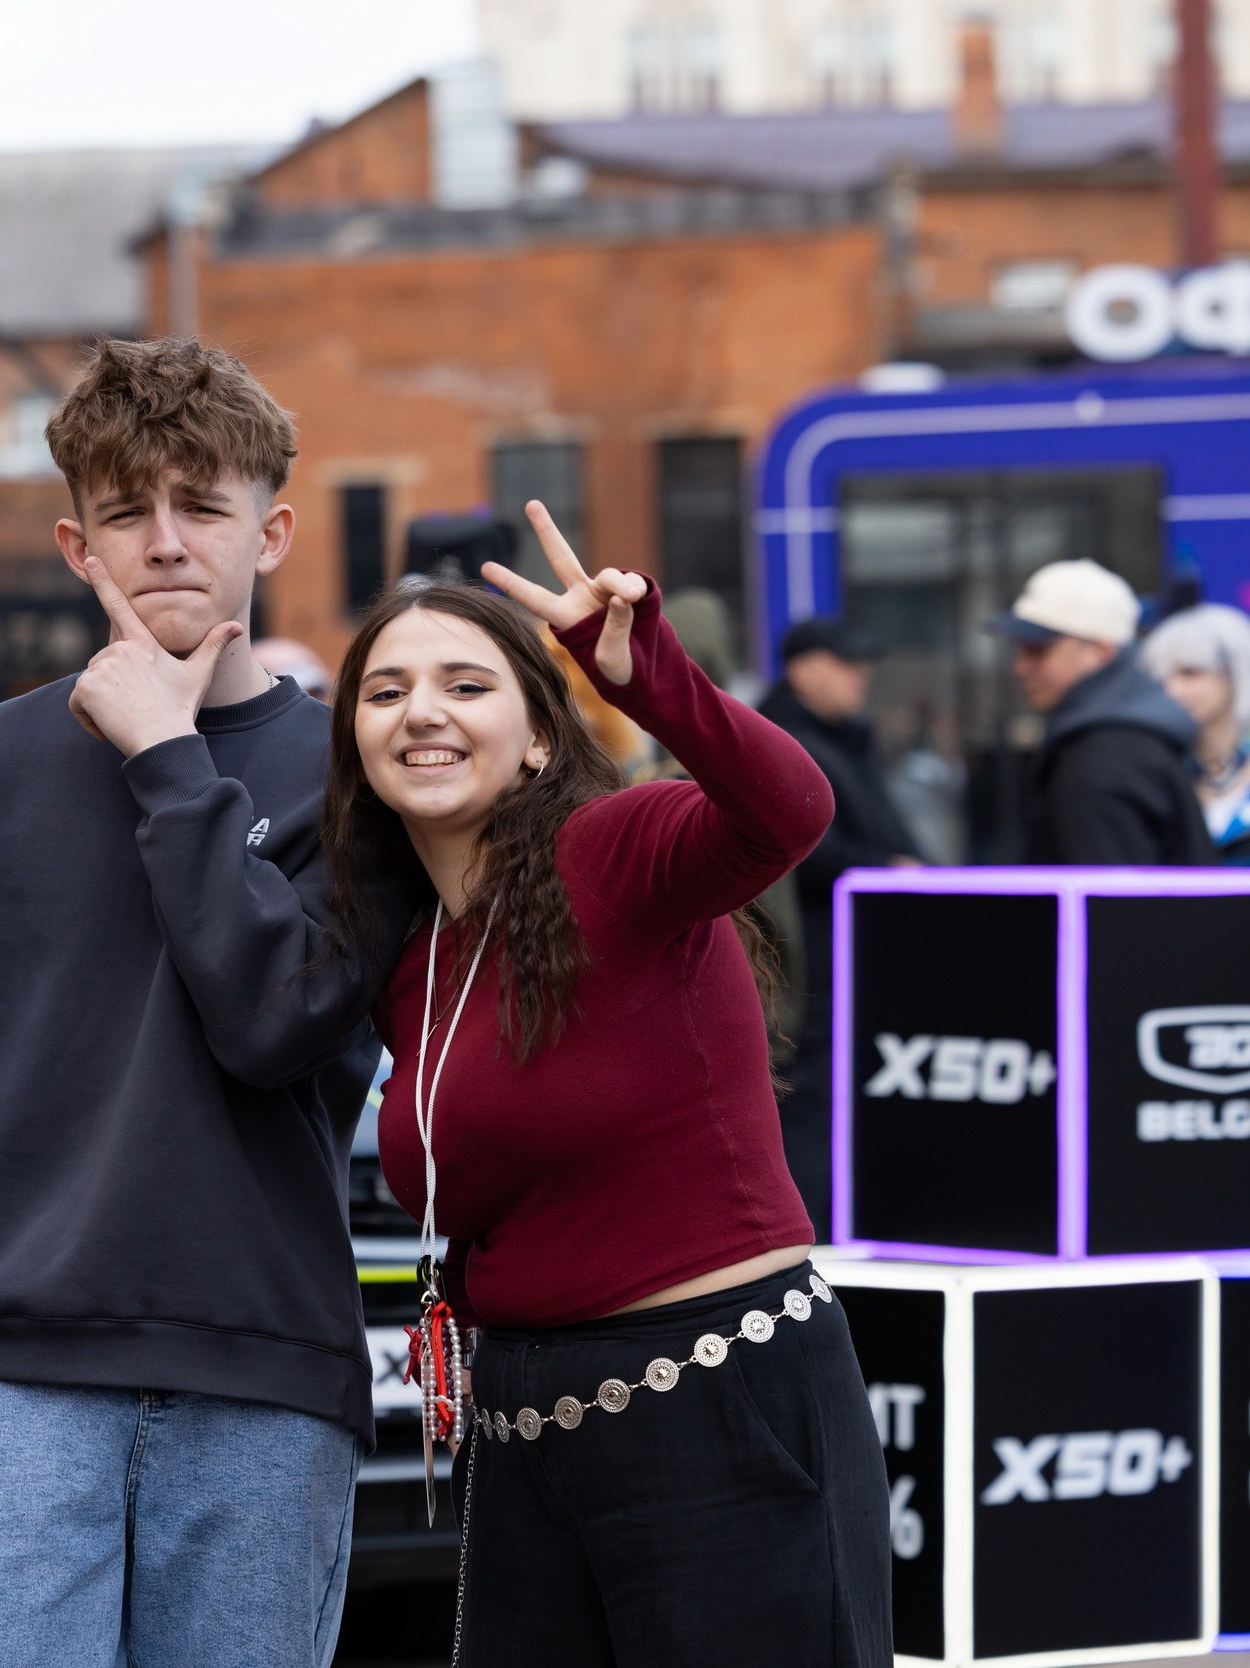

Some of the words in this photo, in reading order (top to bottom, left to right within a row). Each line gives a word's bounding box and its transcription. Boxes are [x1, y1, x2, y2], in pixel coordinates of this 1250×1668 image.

[864, 1032, 1057, 1104] X50+
[1136, 1100, 1250, 1142] BELG
[982, 1427, 1192, 1506] X50+
